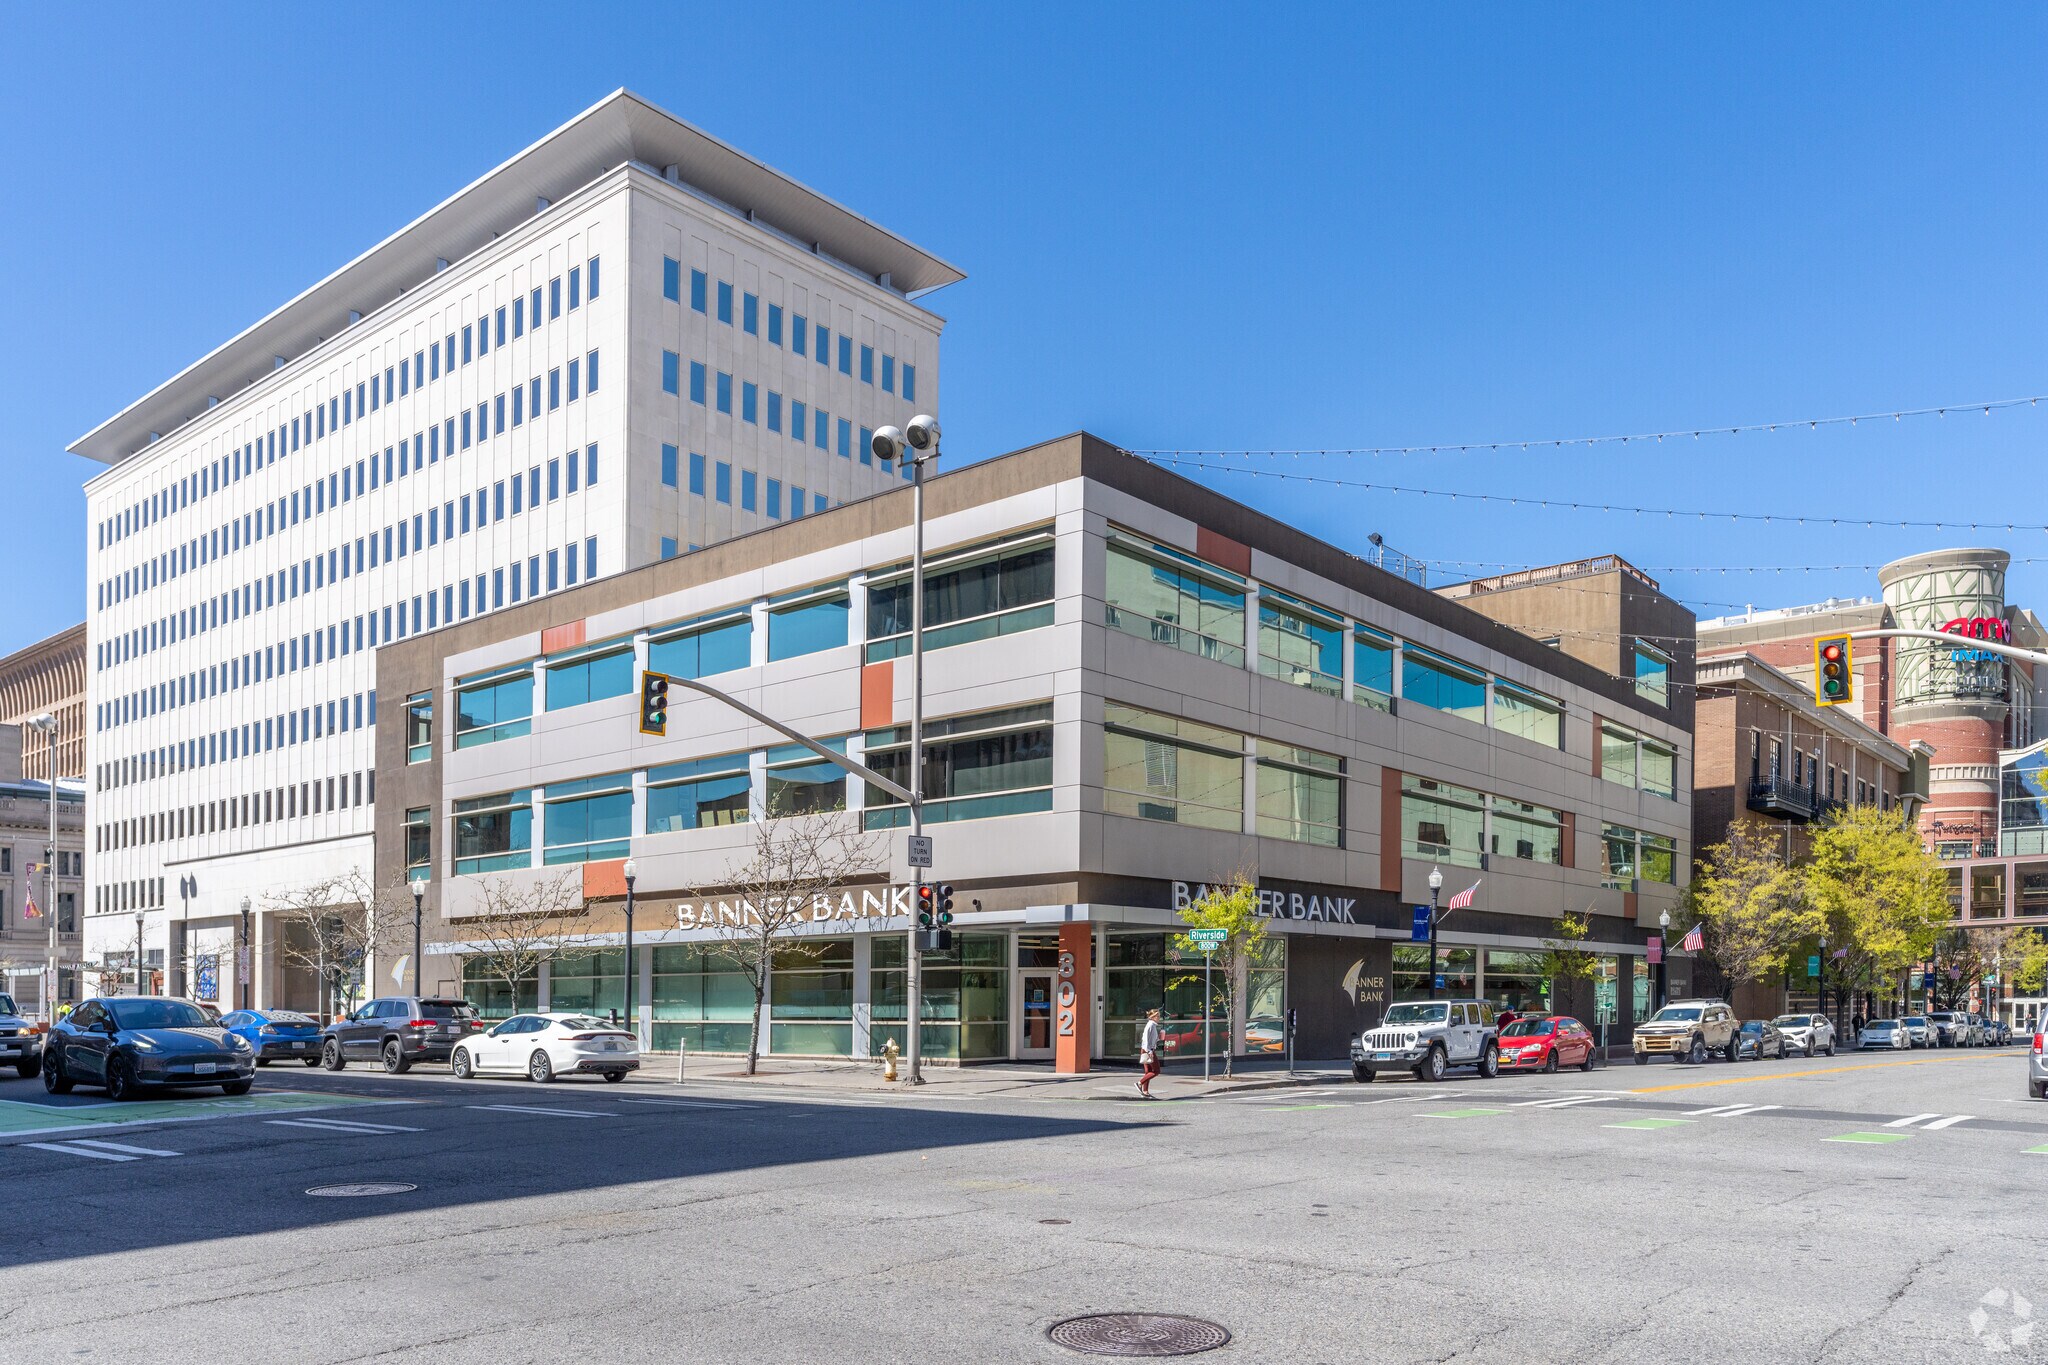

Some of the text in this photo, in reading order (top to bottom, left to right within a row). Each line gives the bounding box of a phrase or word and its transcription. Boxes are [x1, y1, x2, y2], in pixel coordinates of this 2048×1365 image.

[677, 887, 911, 930] BANNER BANK
[1290, 892, 1357, 924] BANK
[1191, 931, 1225, 940] Riverside
[1058, 952, 1076, 1035] 802
[1360, 991, 1384, 1002] BANK
